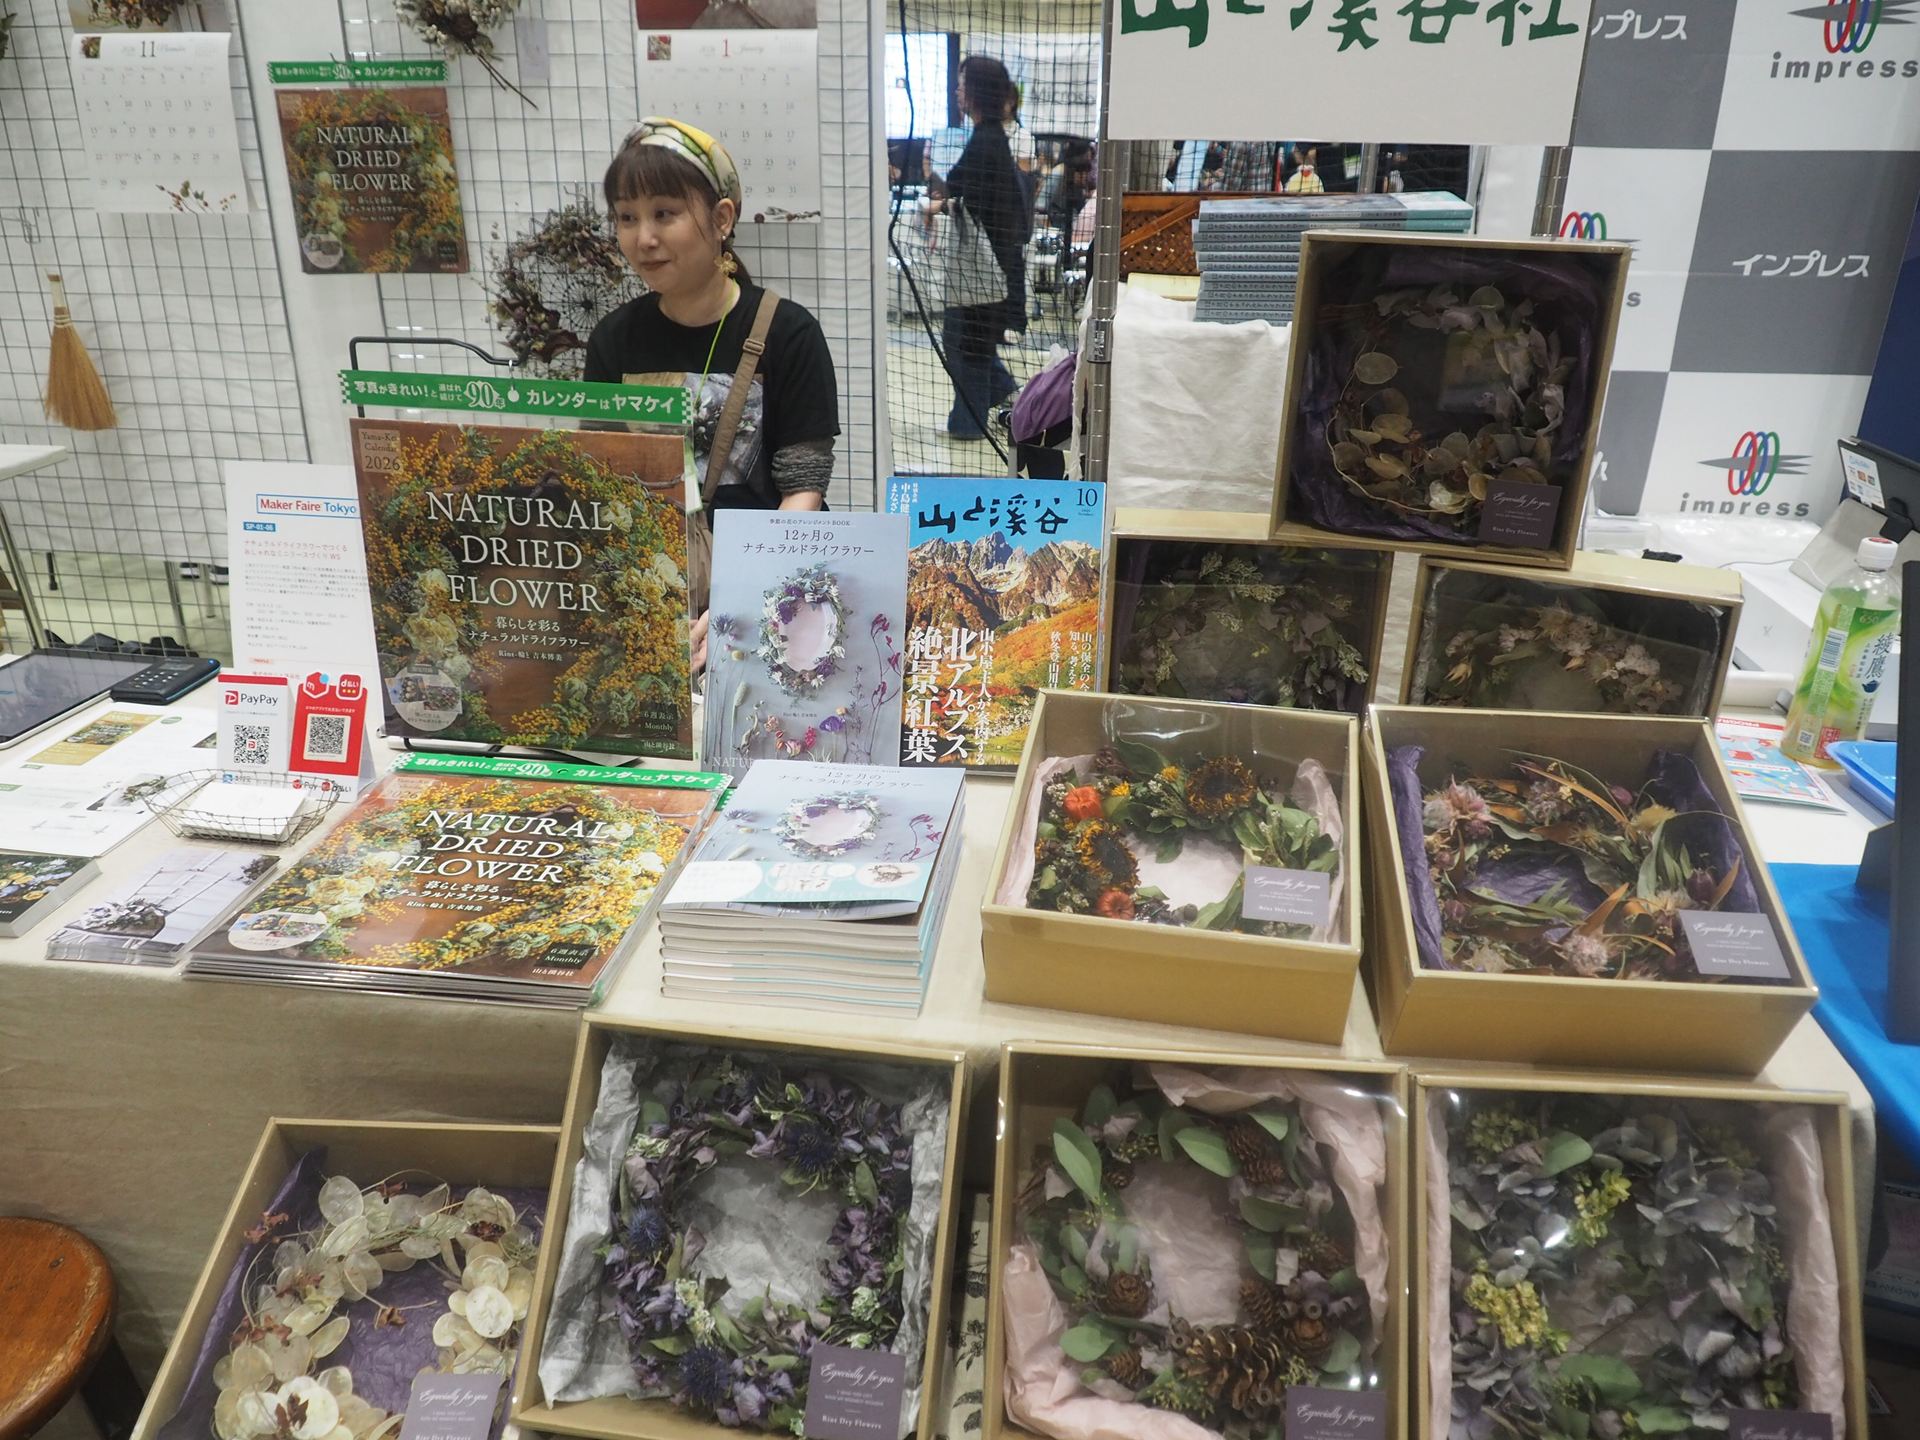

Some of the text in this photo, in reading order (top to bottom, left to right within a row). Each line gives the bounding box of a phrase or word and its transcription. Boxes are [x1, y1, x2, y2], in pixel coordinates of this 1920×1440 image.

[141, 40, 156, 58] 11
[722, 38, 730, 58] 1
[1770, 50, 1919, 83] impress
[316, 126, 414, 145] NATURAL
[336, 150, 400, 169] DRIED
[330, 173, 416, 192] FLOWER
[1732, 249, 1870, 277] インプレス
[527, 389, 675, 415] カレンダーはヤマケイ
[365, 455, 401, 470] 2026
[1076, 488, 1098, 507] 10
[260, 499, 357, 516] Maker Faire Tokyo
[425, 491, 613, 531] NATURAL
[784, 530, 834, 542] 12ヶ月の
[460, 535, 583, 570] DRIED
[743, 543, 875, 557] ナチュラルドライフラワー
[447, 574, 606, 613] FLOWER
[495, 615, 561, 633] 暮らしを彩る
[468, 630, 590, 647] ナチュラルドライフラワー
[240, 693, 279, 706] PayPay
[902, 625, 945, 764] 絶景紅葉
[941, 627, 979, 759] 北アルプス
[975, 627, 995, 766] 山小屋主人が案内する
[644, 722, 673, 732] Monthly
[415, 809, 613, 840] NATURAL
[426, 834, 565, 859] DRIED
[388, 854, 564, 884] FLOWER
[382, 886, 526, 904] ナチュラルドライフラワー
[424, 880, 500, 893] 暮らしを彩る
[545, 955, 582, 965] Monthly
[820, 1362, 866, 1387] Especially
[872, 1376, 895, 1390] you
